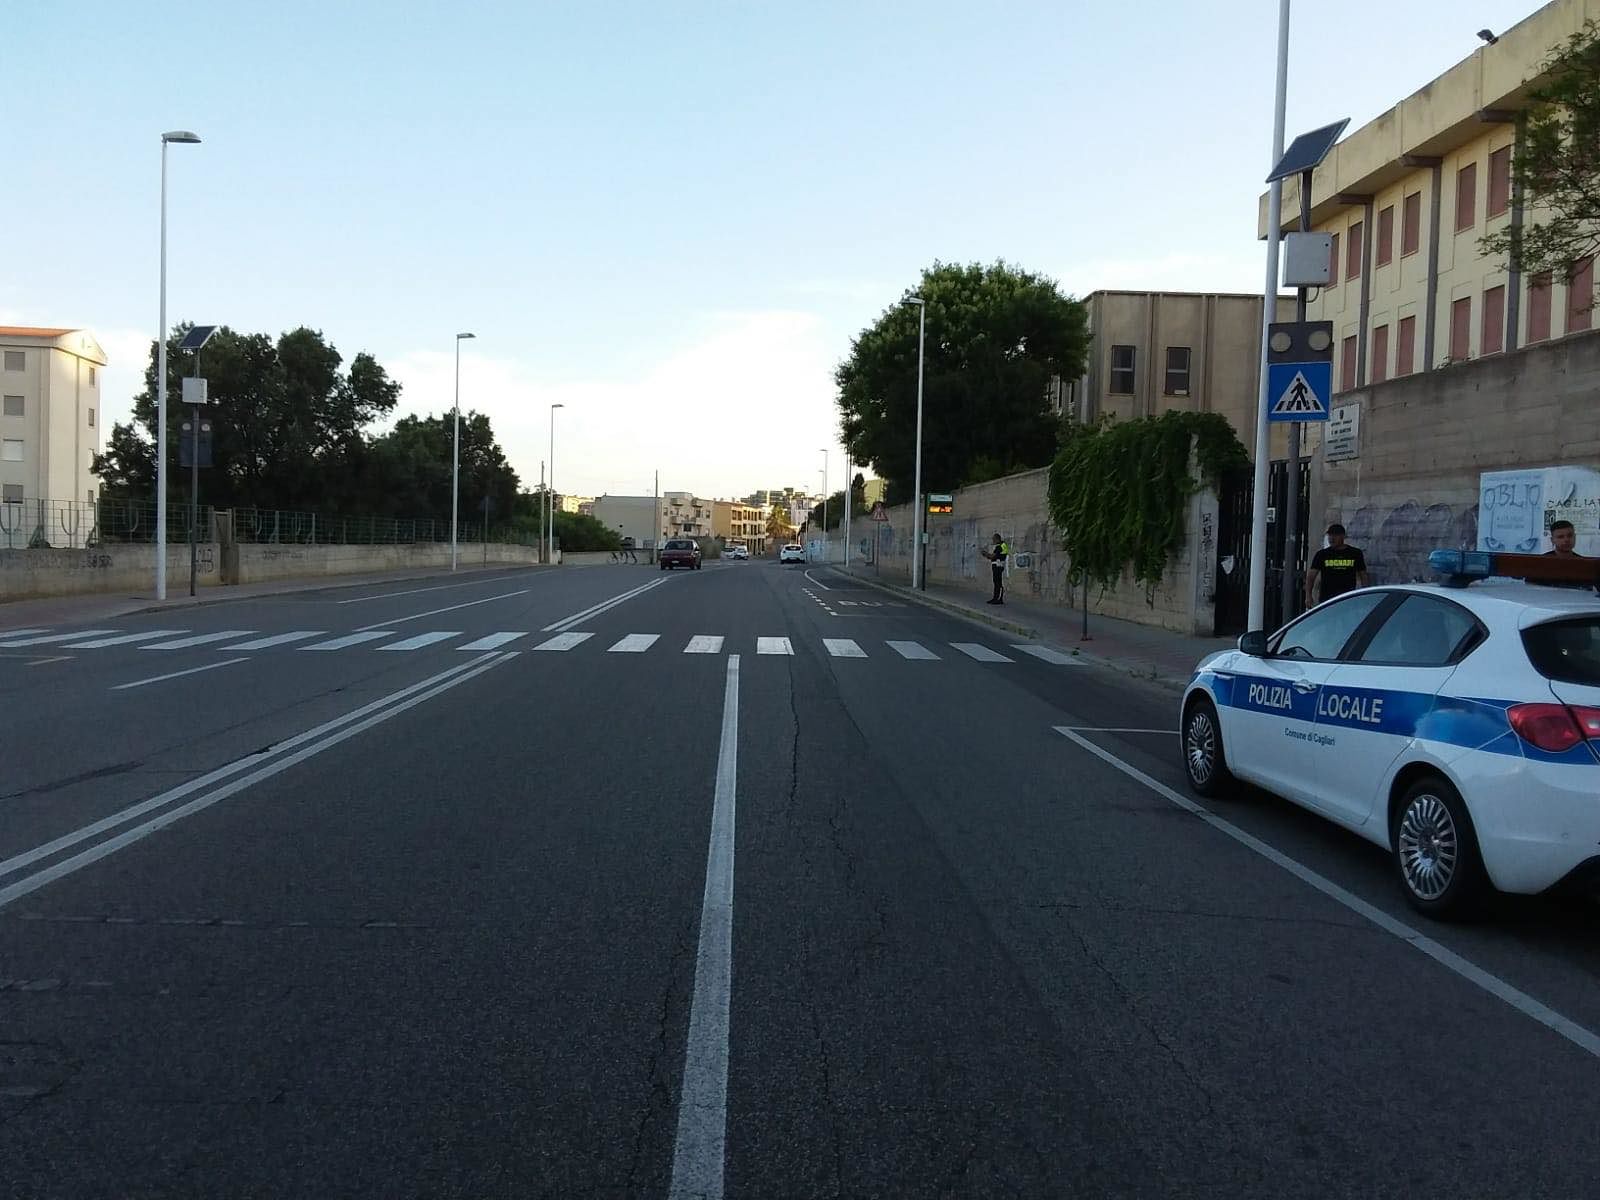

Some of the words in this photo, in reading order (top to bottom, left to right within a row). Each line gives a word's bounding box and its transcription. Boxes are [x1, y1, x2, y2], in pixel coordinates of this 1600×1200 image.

[1484, 483, 1541, 511] OBLIO
[1546, 498, 1600, 509] CAGLIA
[1248, 683, 1292, 710] POLIZIA
[1318, 693, 1384, 723] LOCALE
[1284, 727, 1306, 741] Comune
[1307, 733, 1313, 742] di
[1313, 733, 1336, 746] Cagliari
